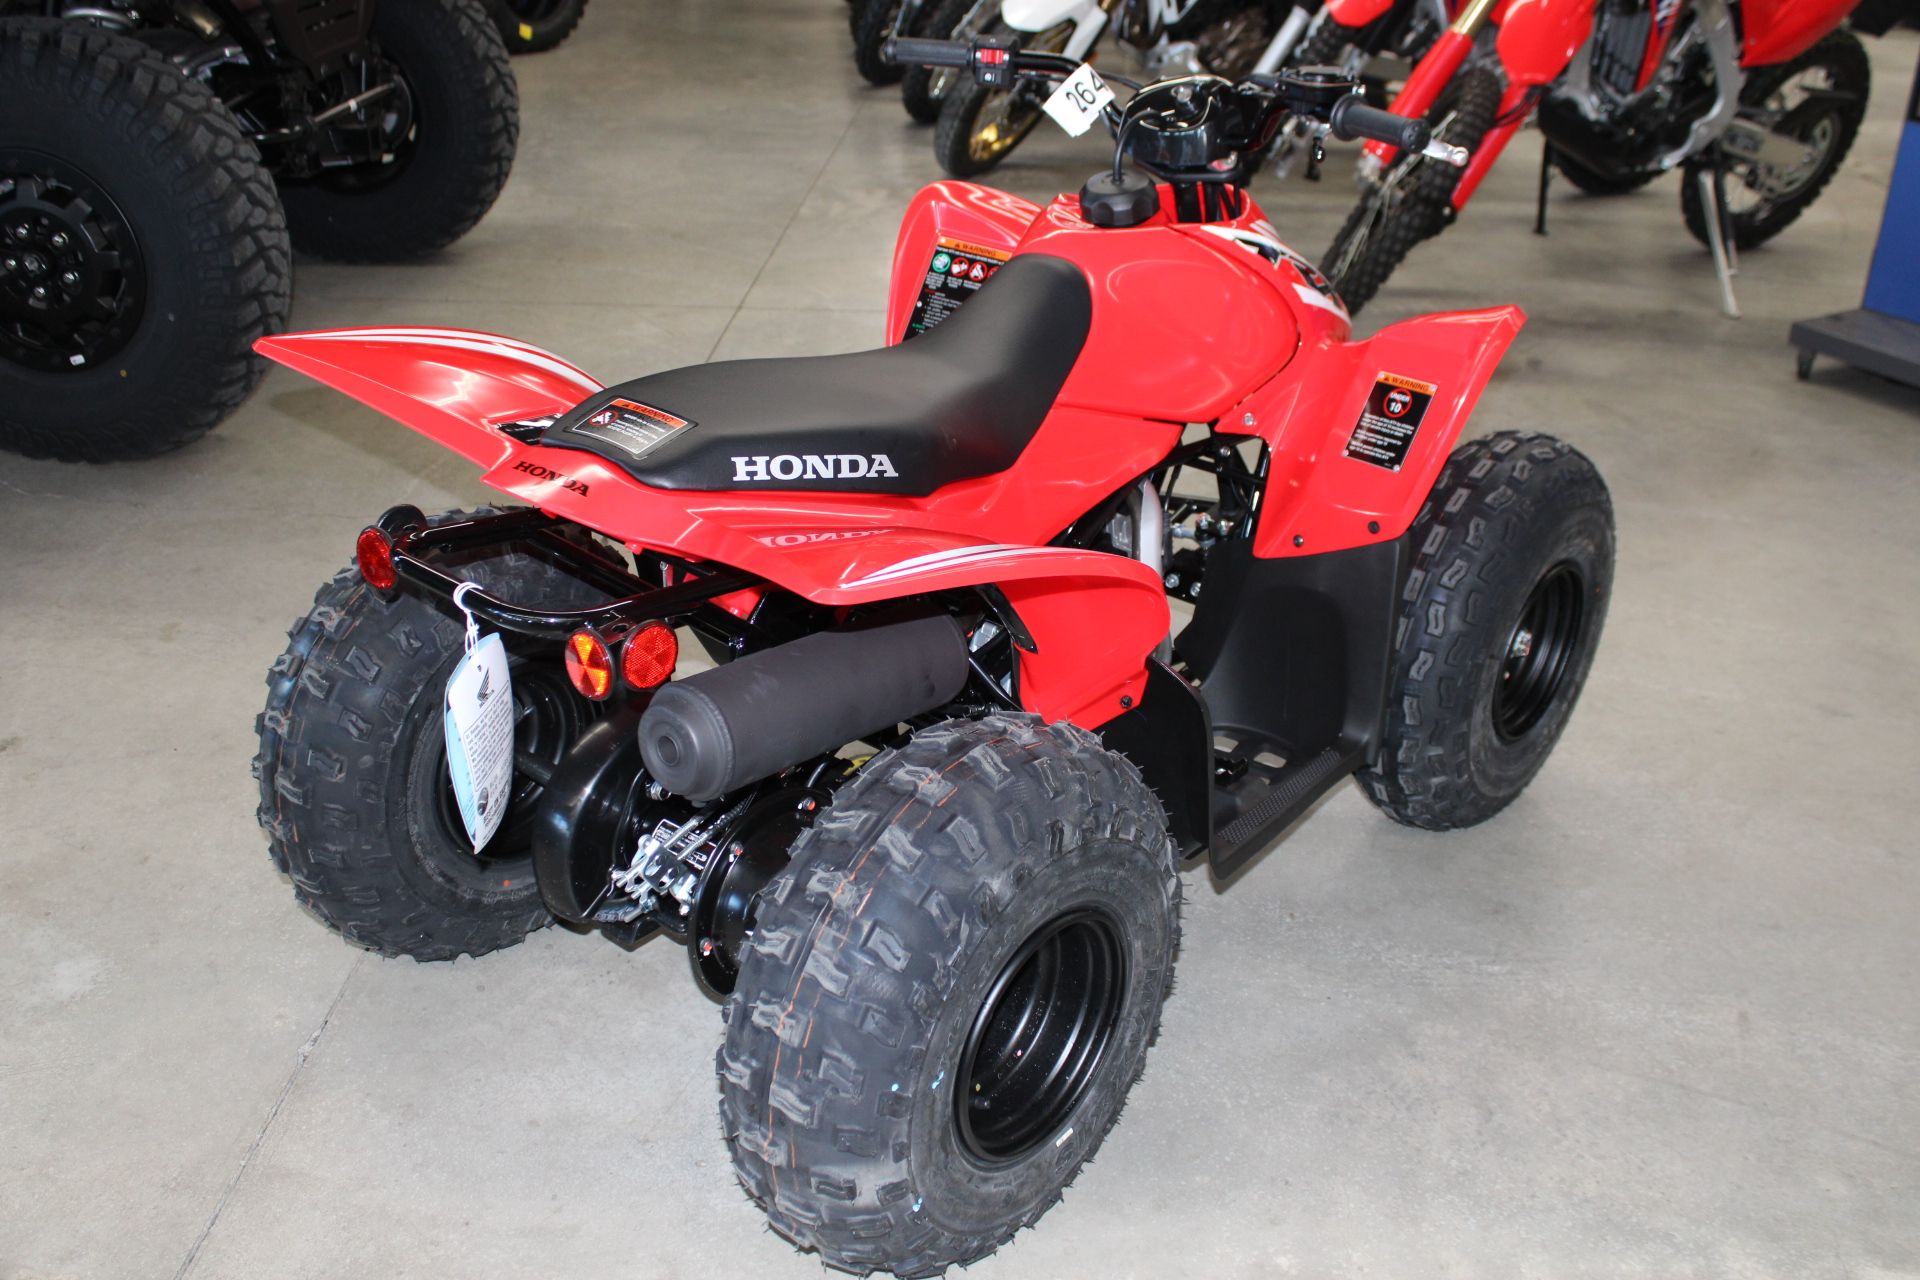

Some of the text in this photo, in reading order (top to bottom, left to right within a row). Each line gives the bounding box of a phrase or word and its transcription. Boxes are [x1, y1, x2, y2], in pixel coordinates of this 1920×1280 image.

[1065, 70, 1109, 113] 264
[963, 243, 996, 257] WARNING
[1392, 377, 1429, 392] WARNING
[1390, 392, 1410, 403] UNDER
[632, 405, 674, 423] WARNING
[1390, 402, 1402, 413] 10
[730, 454, 899, 482] HONDA
[512, 460, 590, 498] HONDA
